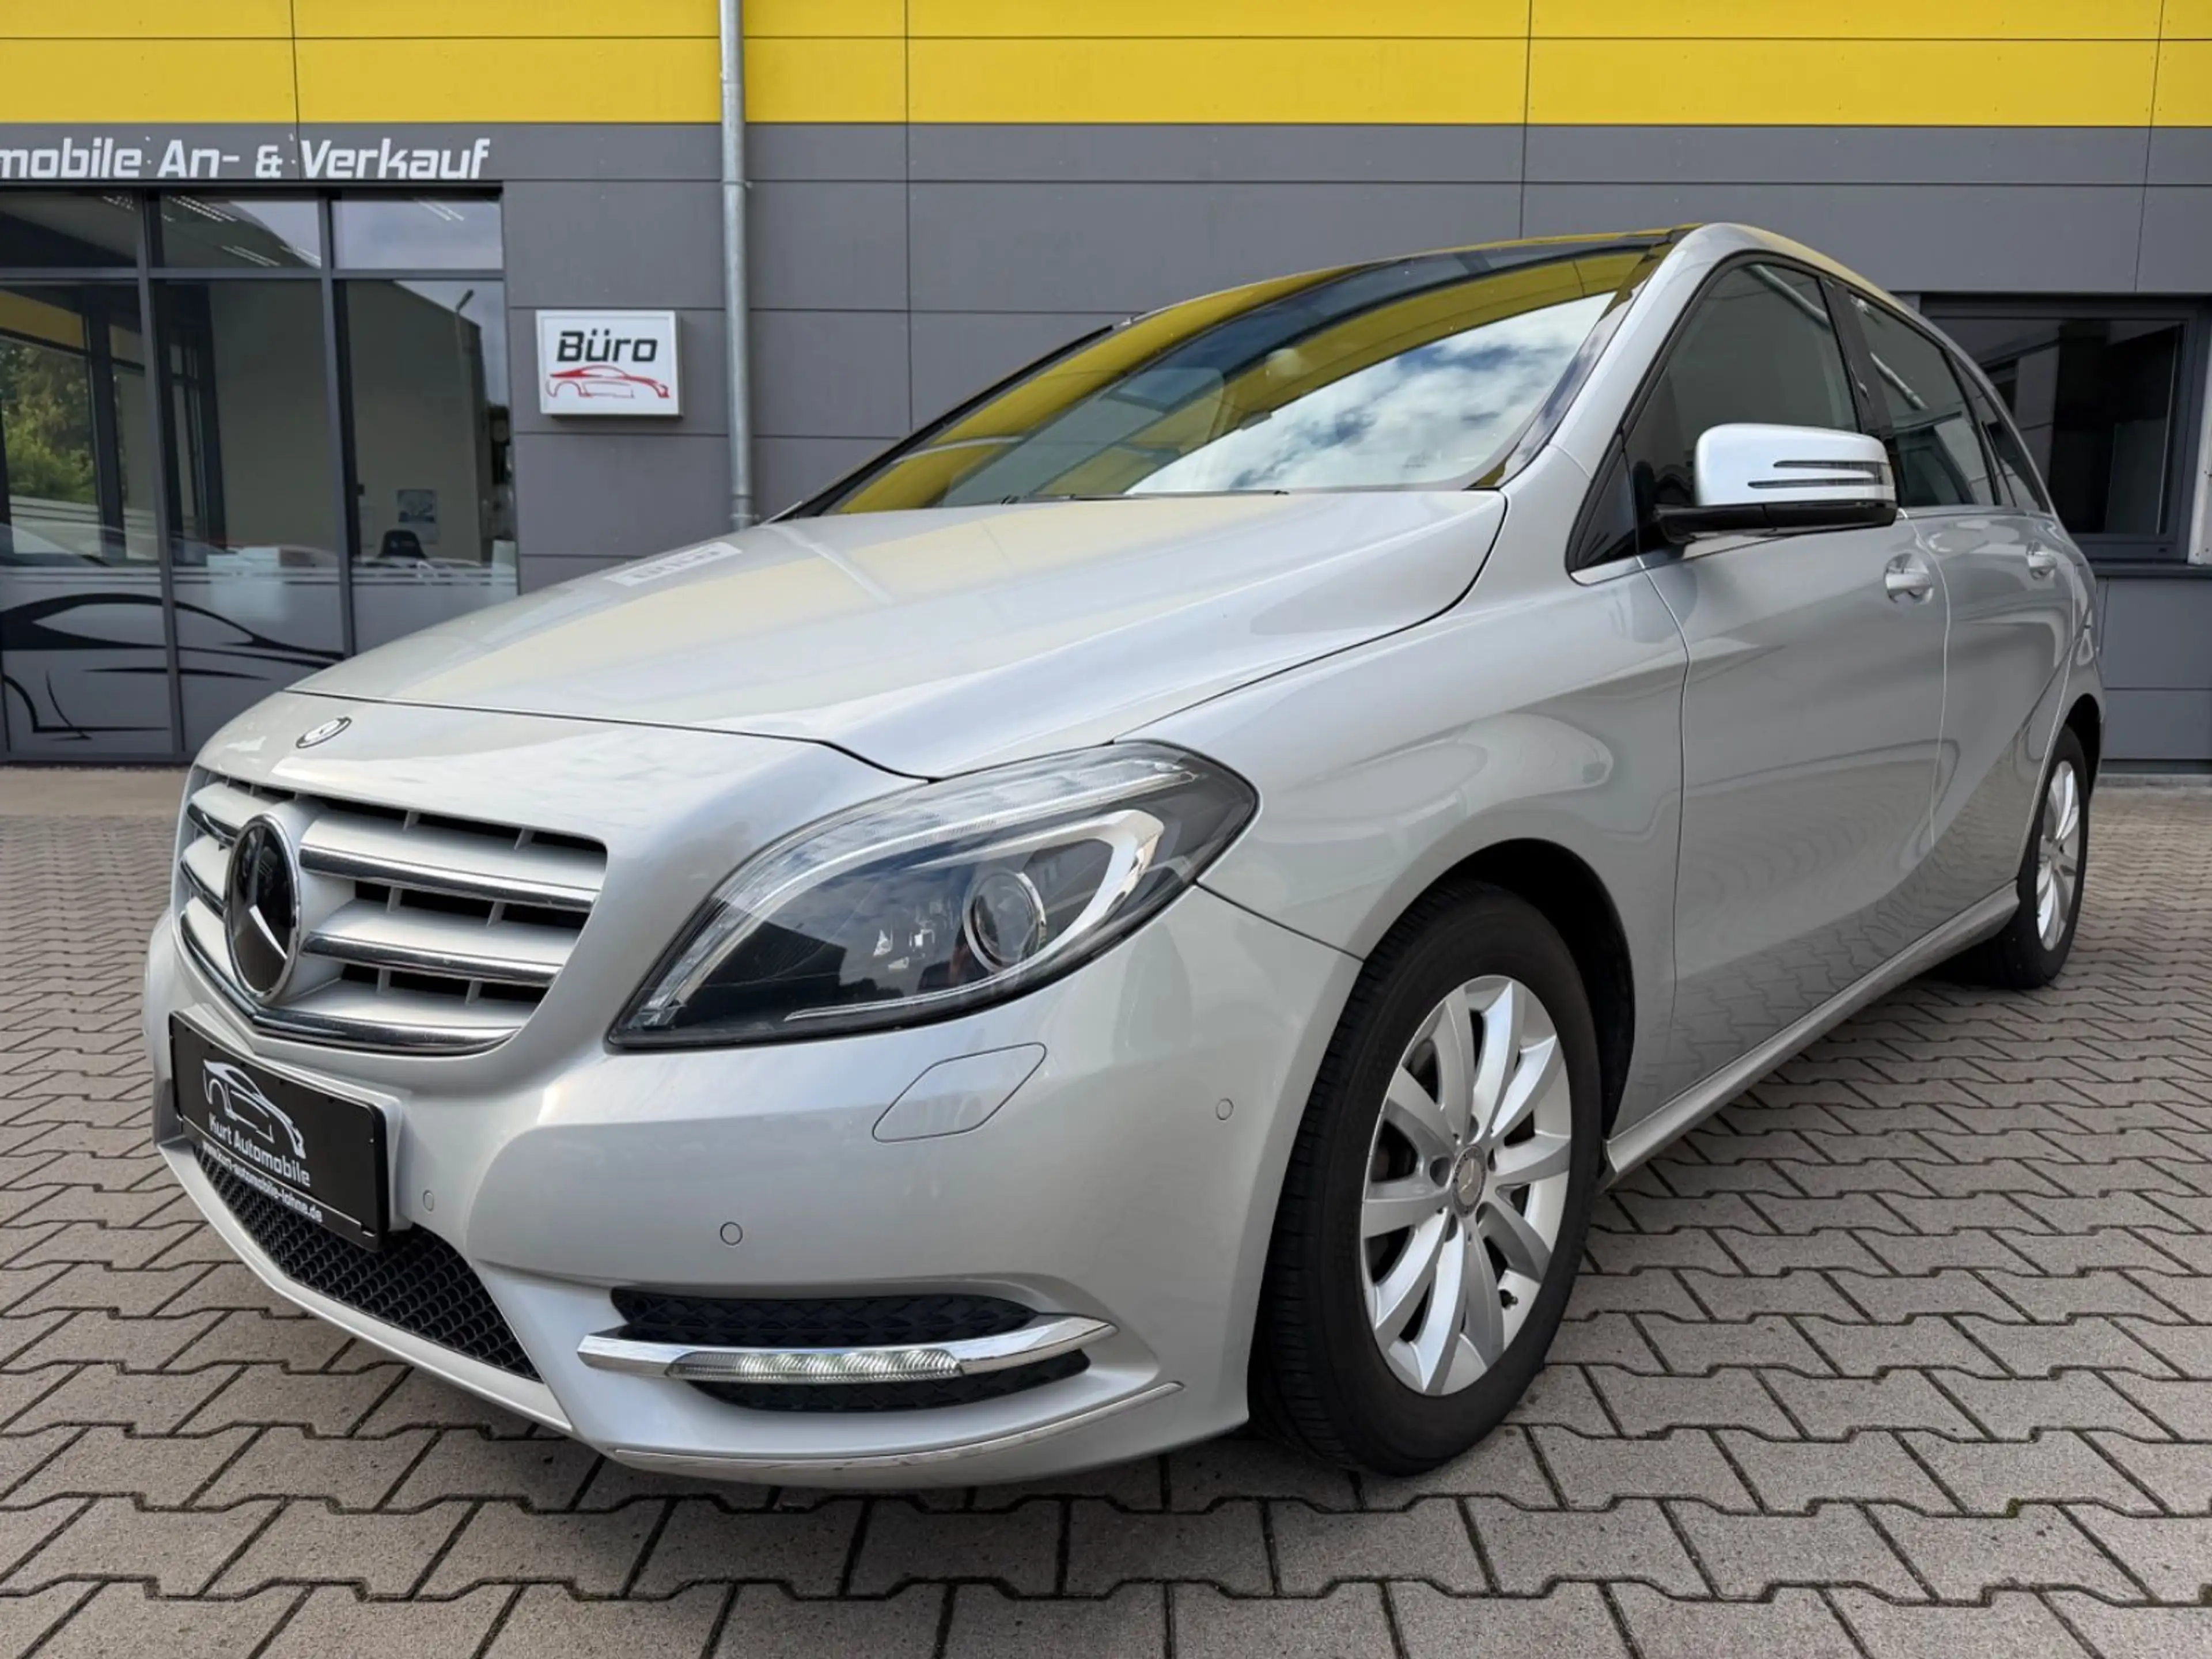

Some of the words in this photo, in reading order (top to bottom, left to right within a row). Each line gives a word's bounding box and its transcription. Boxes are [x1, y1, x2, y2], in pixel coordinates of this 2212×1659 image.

[157, 139, 240, 178] An-
[255, 145, 283, 178] &
[301, 138, 490, 179] Verkauf
[556, 328, 658, 362] Büro
[209, 1111, 232, 1145] Kurt
[233, 1129, 311, 1187] Automobile
